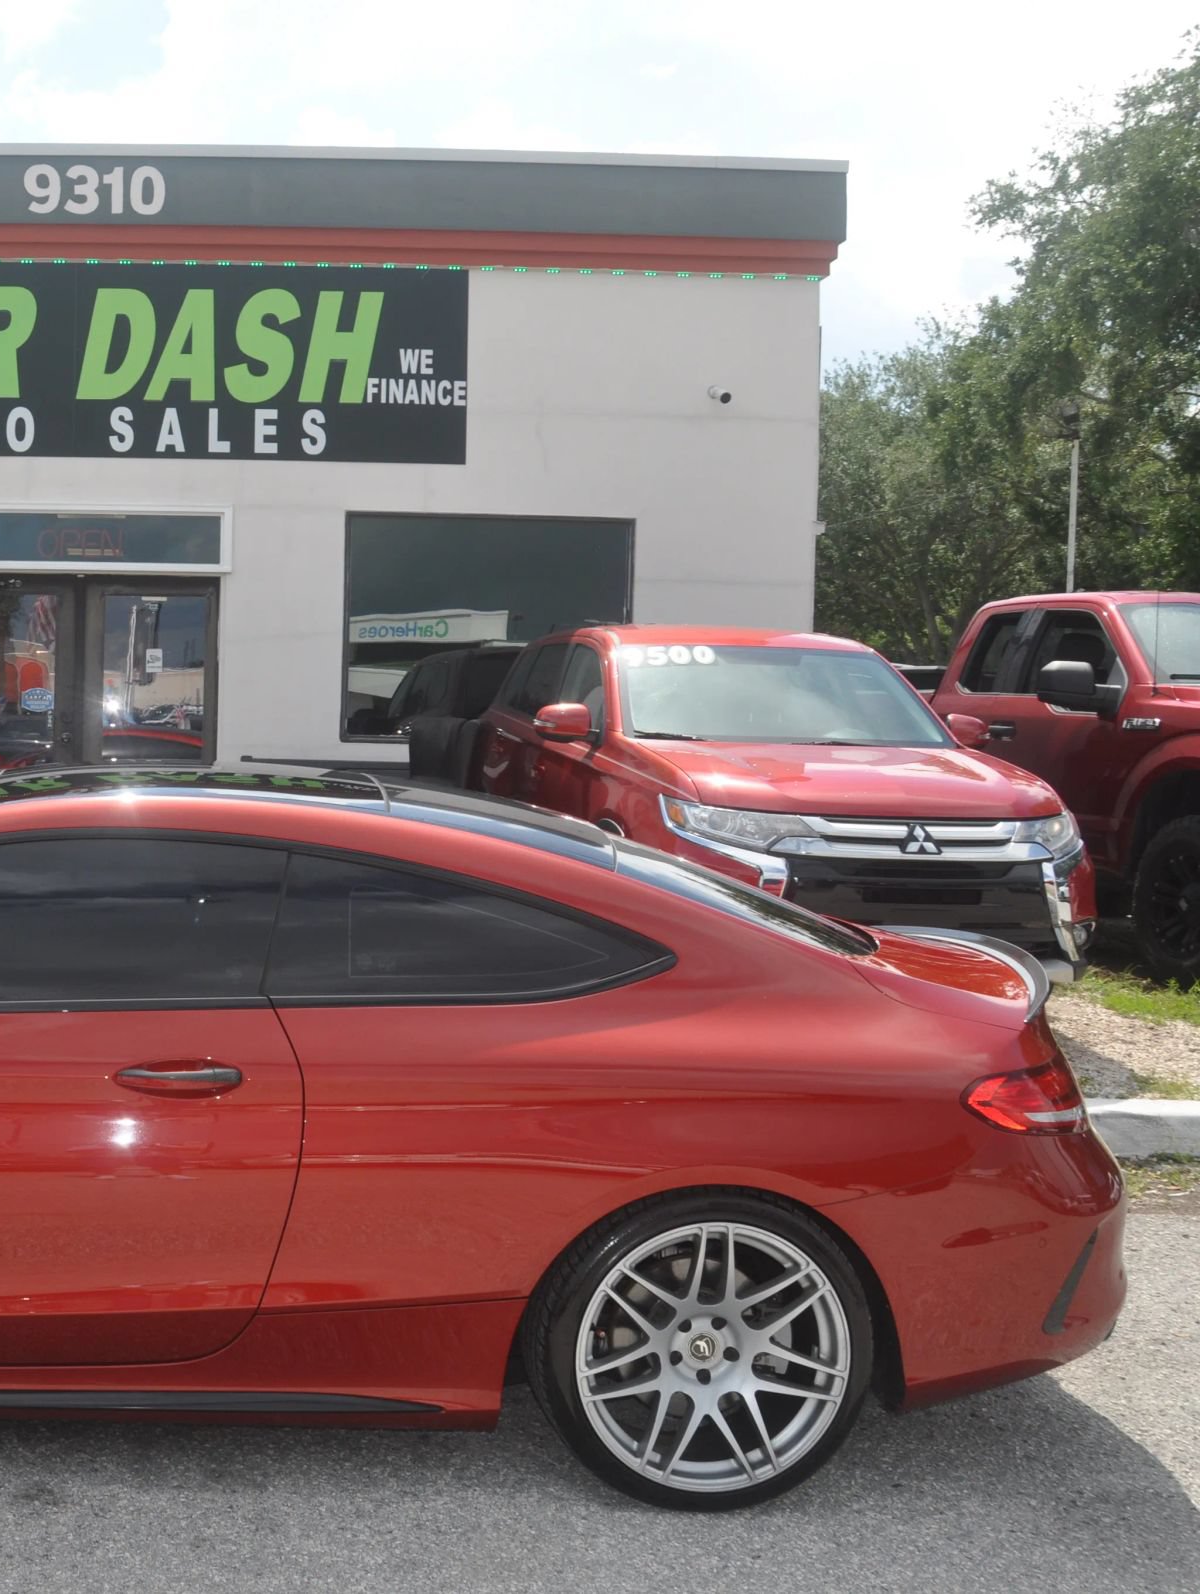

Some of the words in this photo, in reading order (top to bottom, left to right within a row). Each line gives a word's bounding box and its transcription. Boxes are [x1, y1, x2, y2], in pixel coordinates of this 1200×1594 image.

[23, 163, 166, 216] 9310
[77, 287, 385, 404] DASH
[399, 348, 434, 375] WE
[366, 377, 467, 407] FINANCE
[108, 406, 328, 456] SALES
[37, 528, 126, 559] OPEN
